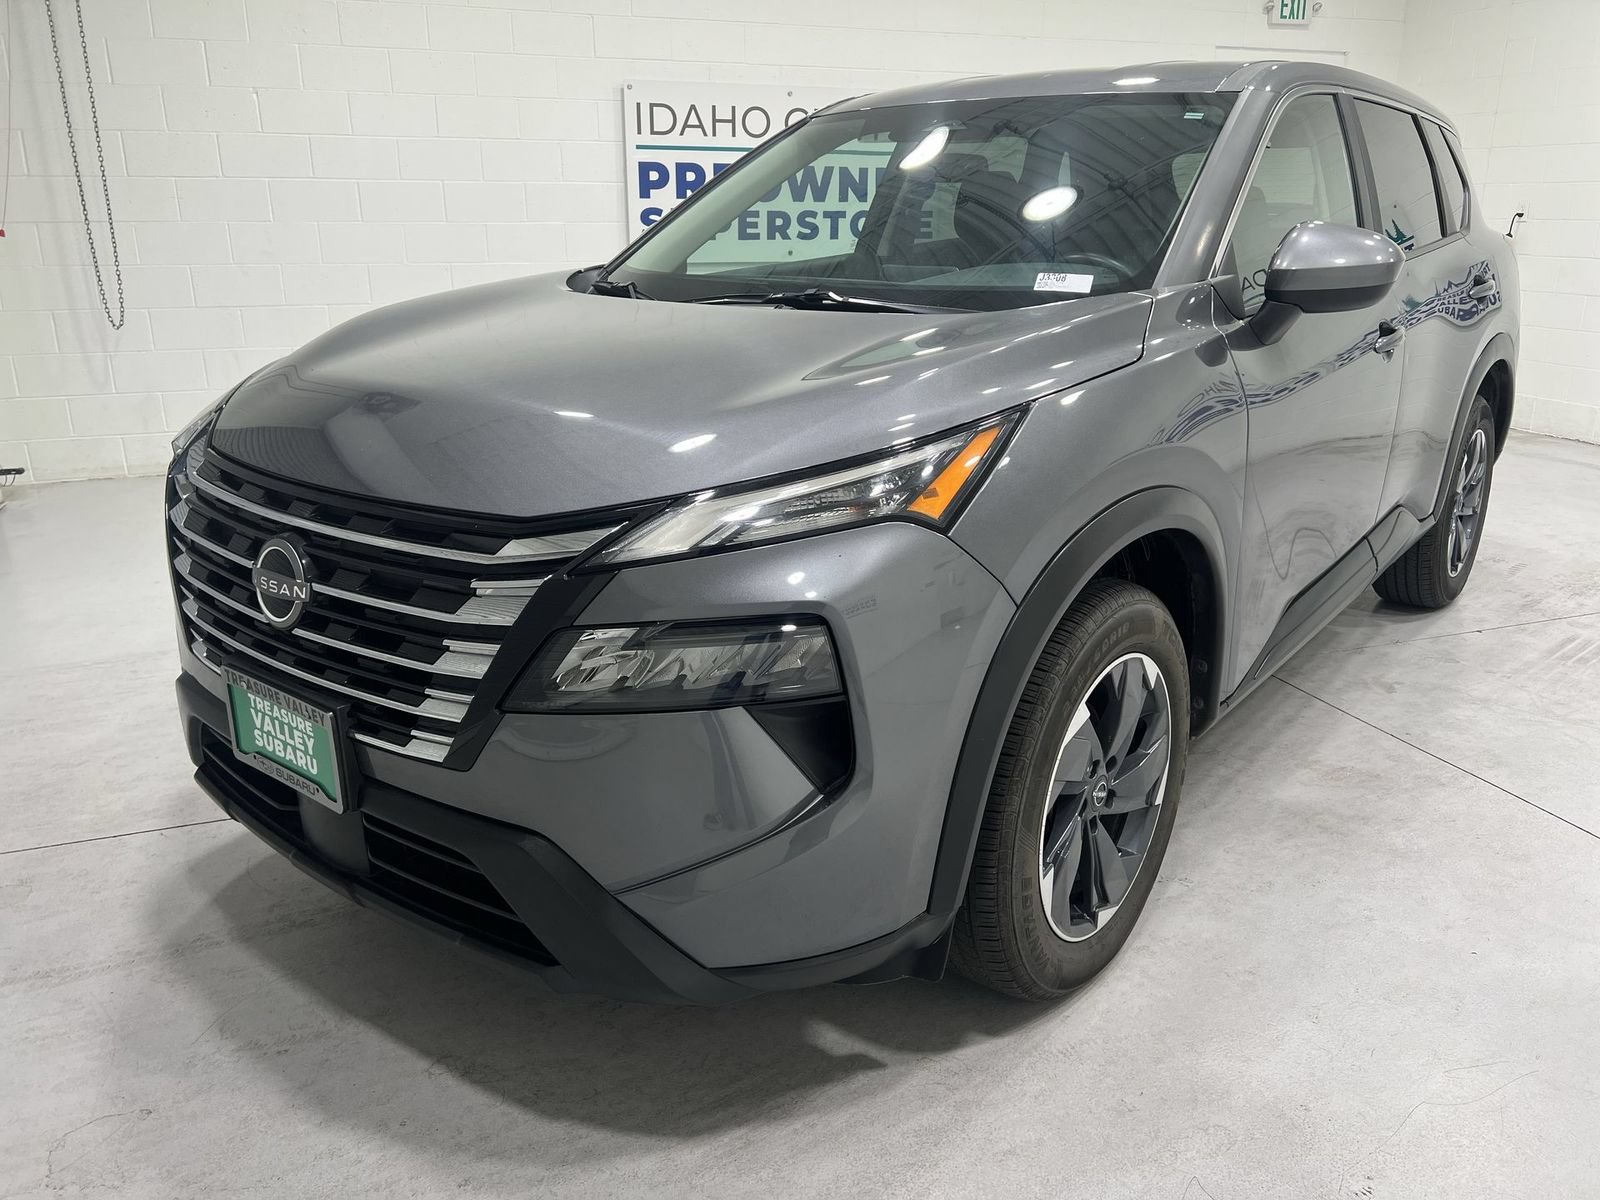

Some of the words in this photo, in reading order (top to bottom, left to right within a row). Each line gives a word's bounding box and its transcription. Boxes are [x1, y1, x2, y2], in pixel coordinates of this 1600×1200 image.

[636, 102, 771, 138] IDAHO
[260, 576, 306, 599] SSAN
[224, 669, 281, 704] TREASURE
[283, 696, 326, 727] VALLEY
[247, 693, 314, 737] TREASURE
[250, 708, 315, 755] VALLEY
[253, 729, 318, 775] SUBARU
[275, 768, 316, 796] SUBARU
